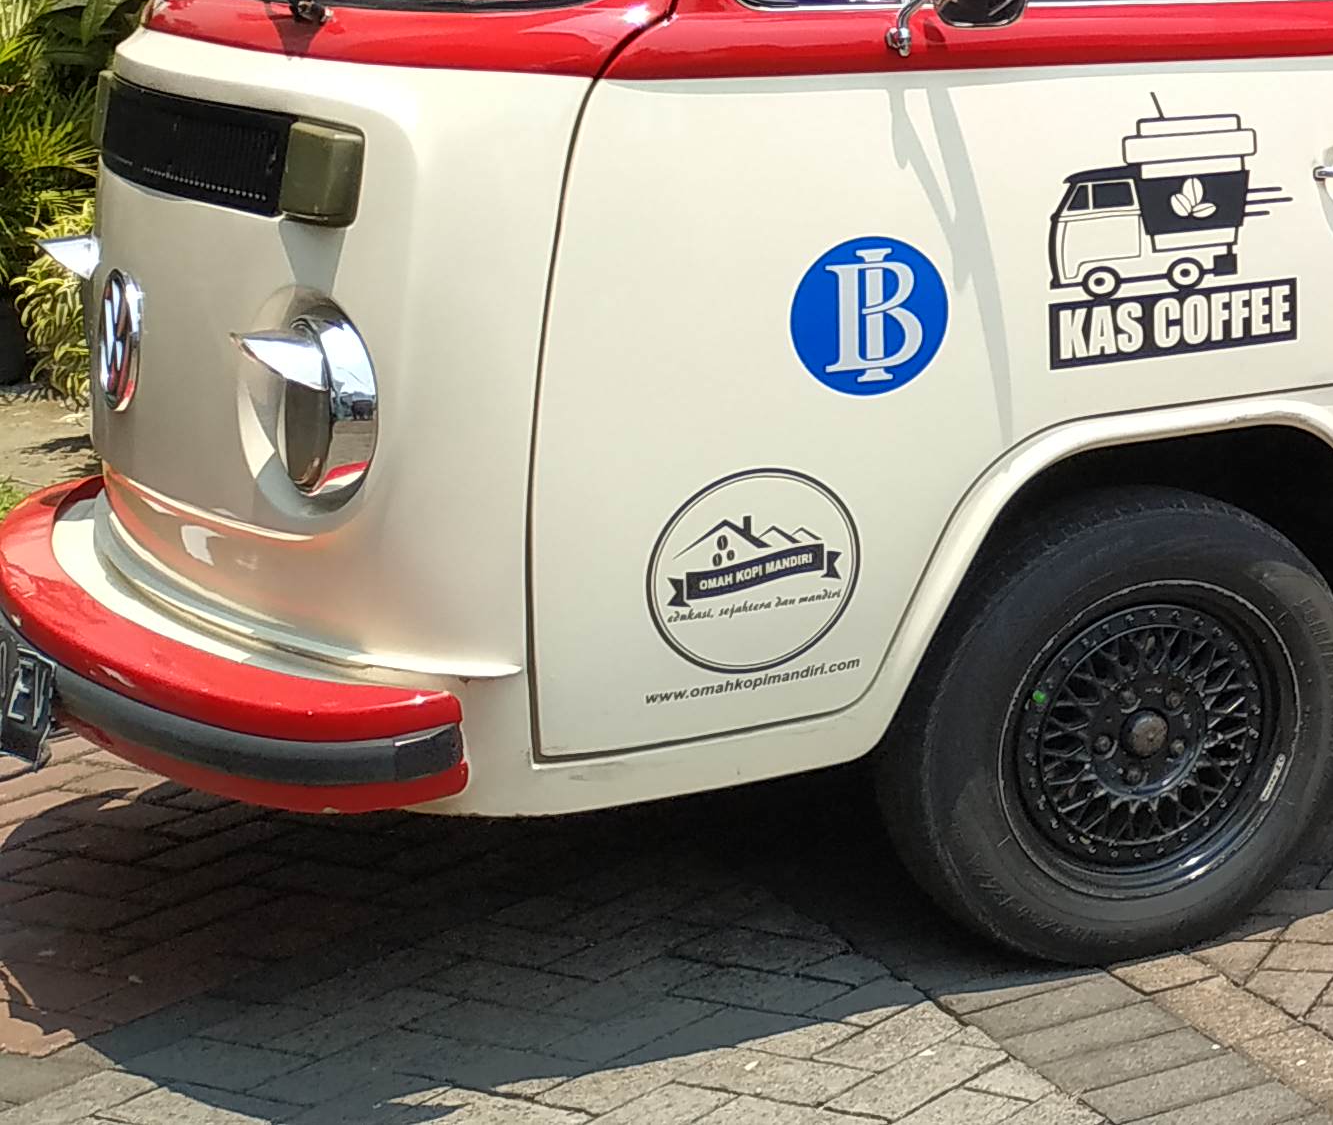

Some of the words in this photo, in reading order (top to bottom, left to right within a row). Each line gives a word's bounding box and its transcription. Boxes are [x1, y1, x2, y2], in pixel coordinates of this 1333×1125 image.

[1060, 301, 1144, 361] KAS
[1152, 284, 1292, 349] COFFEE
[699, 576, 734, 592] OMAH
[735, 565, 764, 584] KOPI
[764, 553, 813, 575] MANDIRI
[774, 595, 796, 609] dan
[798, 588, 842, 605] mandiri
[645, 656, 860, 705] www.omahkopimandiri.com
